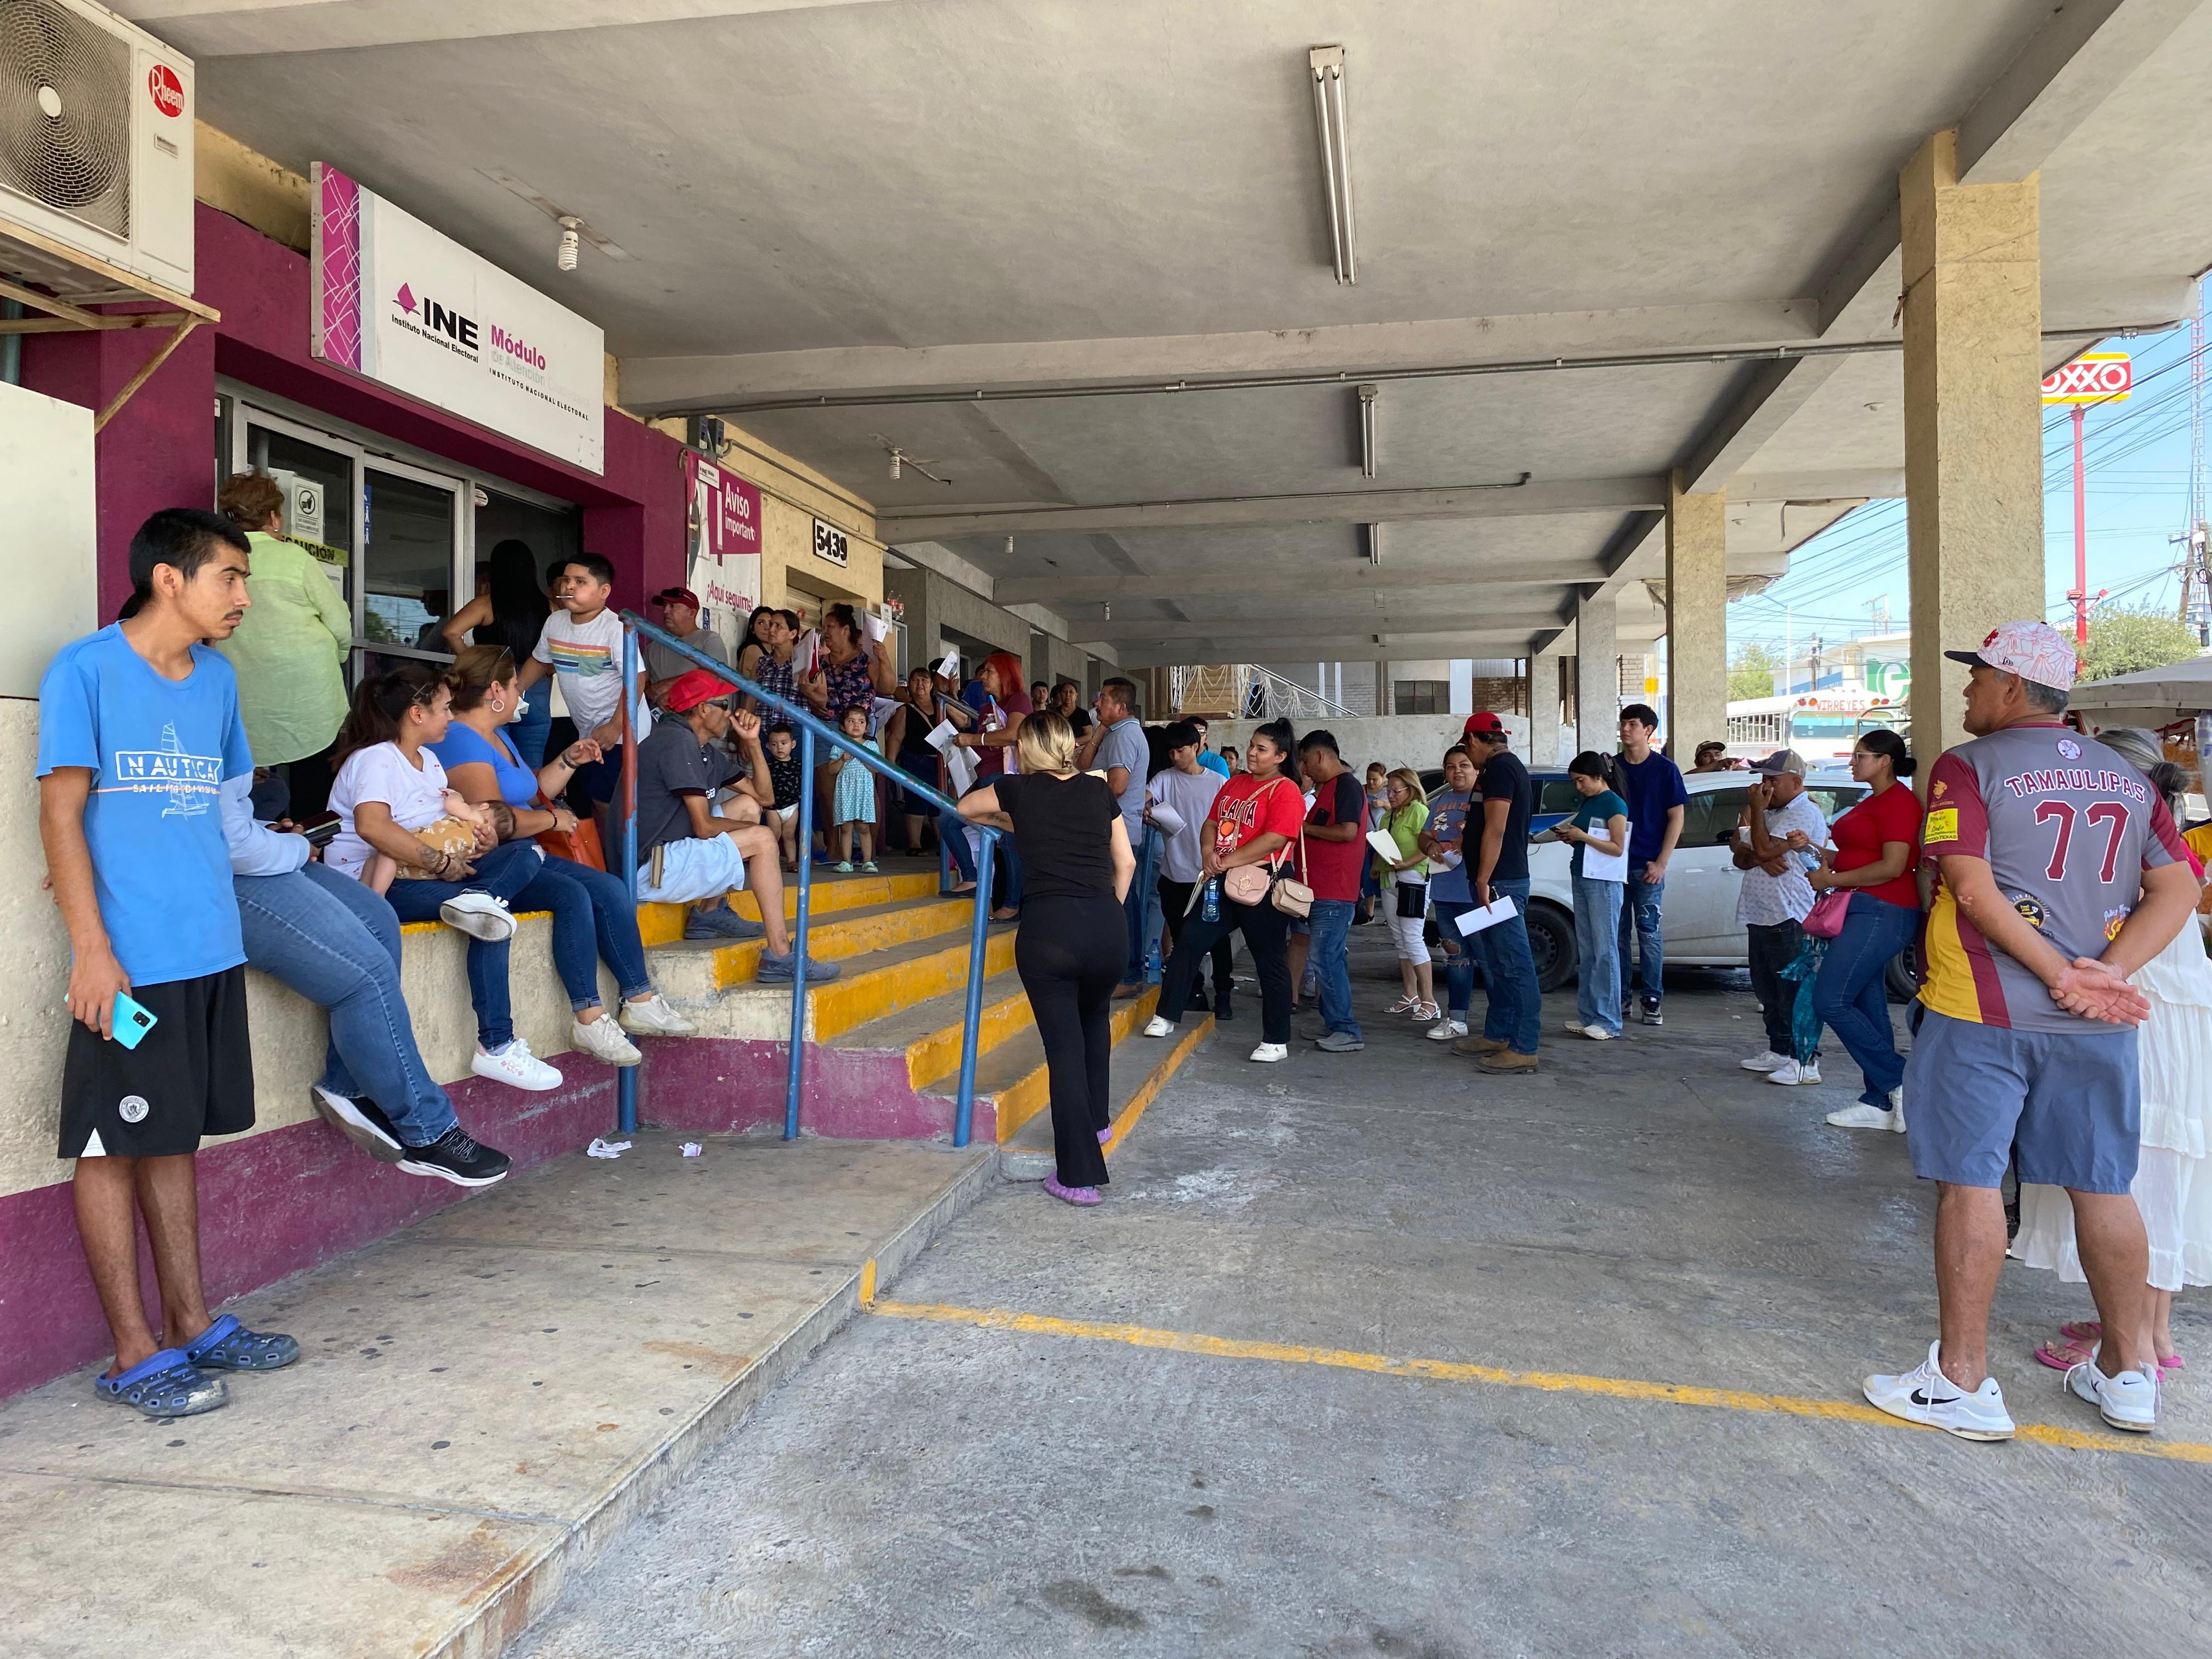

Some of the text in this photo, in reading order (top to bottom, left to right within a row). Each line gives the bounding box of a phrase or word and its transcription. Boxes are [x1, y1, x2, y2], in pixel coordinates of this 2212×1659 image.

[152, 65, 183, 110] Rheem
[392, 314, 478, 363] Instituto Nacional Electoral
[424, 297, 478, 351] INE
[491, 324, 546, 370] Módulo
[489, 368, 588, 420] INSTITUTO NACIONAL ELECTORAL
[725, 482, 749, 519] Aviso
[725, 511, 755, 541] important
[816, 525, 847, 561] 5439
[1816, 699, 1865, 711] VIRREYES
[128, 757, 215, 781] NAUTICA
[2004, 769, 2145, 803] TAMAULIPAS
[2033, 800, 2131, 884] 77
